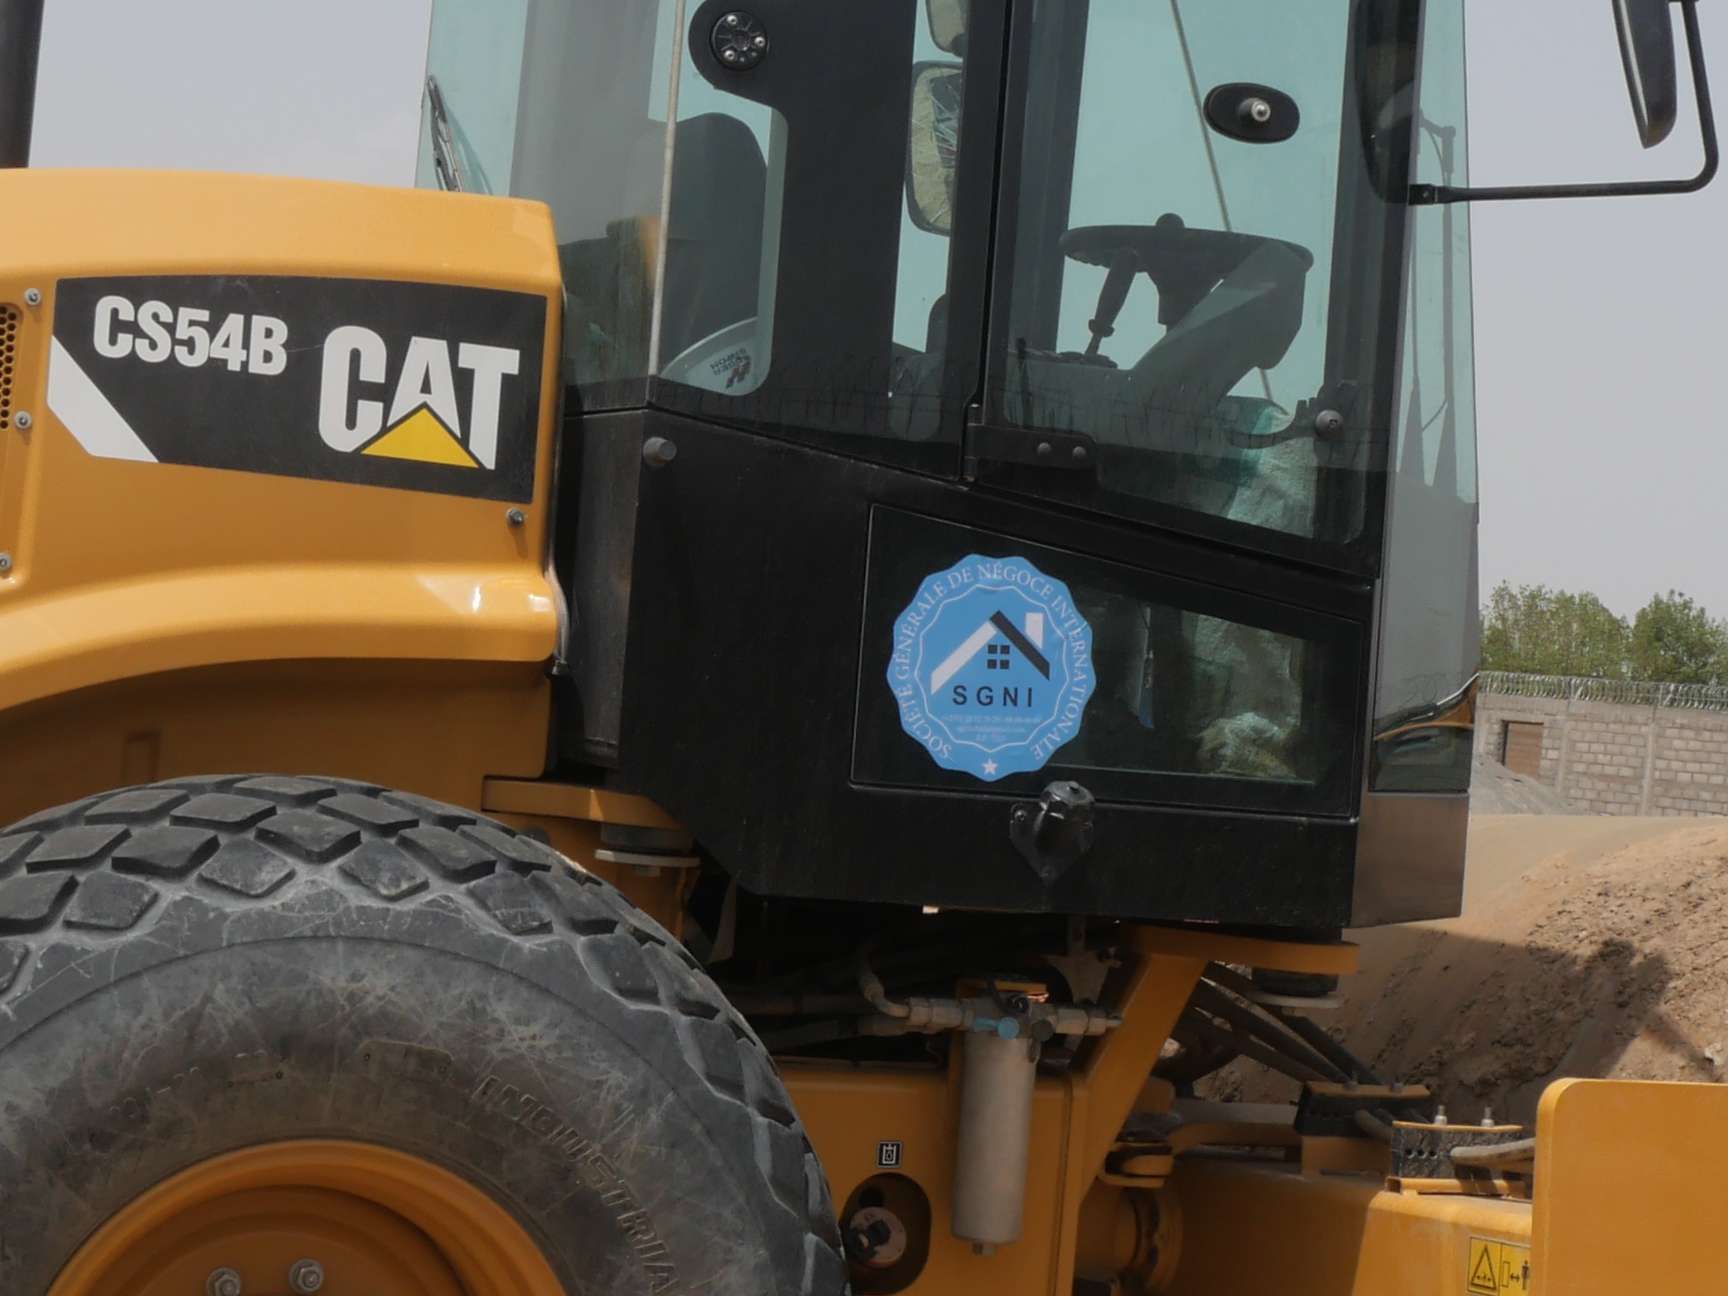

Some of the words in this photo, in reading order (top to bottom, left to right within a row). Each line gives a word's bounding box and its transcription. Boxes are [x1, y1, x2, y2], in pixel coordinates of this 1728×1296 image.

[93, 295, 289, 376] CS54B
[318, 325, 520, 471] CAT
[947, 567, 975, 589] DE
[977, 561, 1054, 599] NÉGOCE
[1030, 595, 1088, 760] INTERNATIONALE
[952, 685, 1033, 708] SGNI
